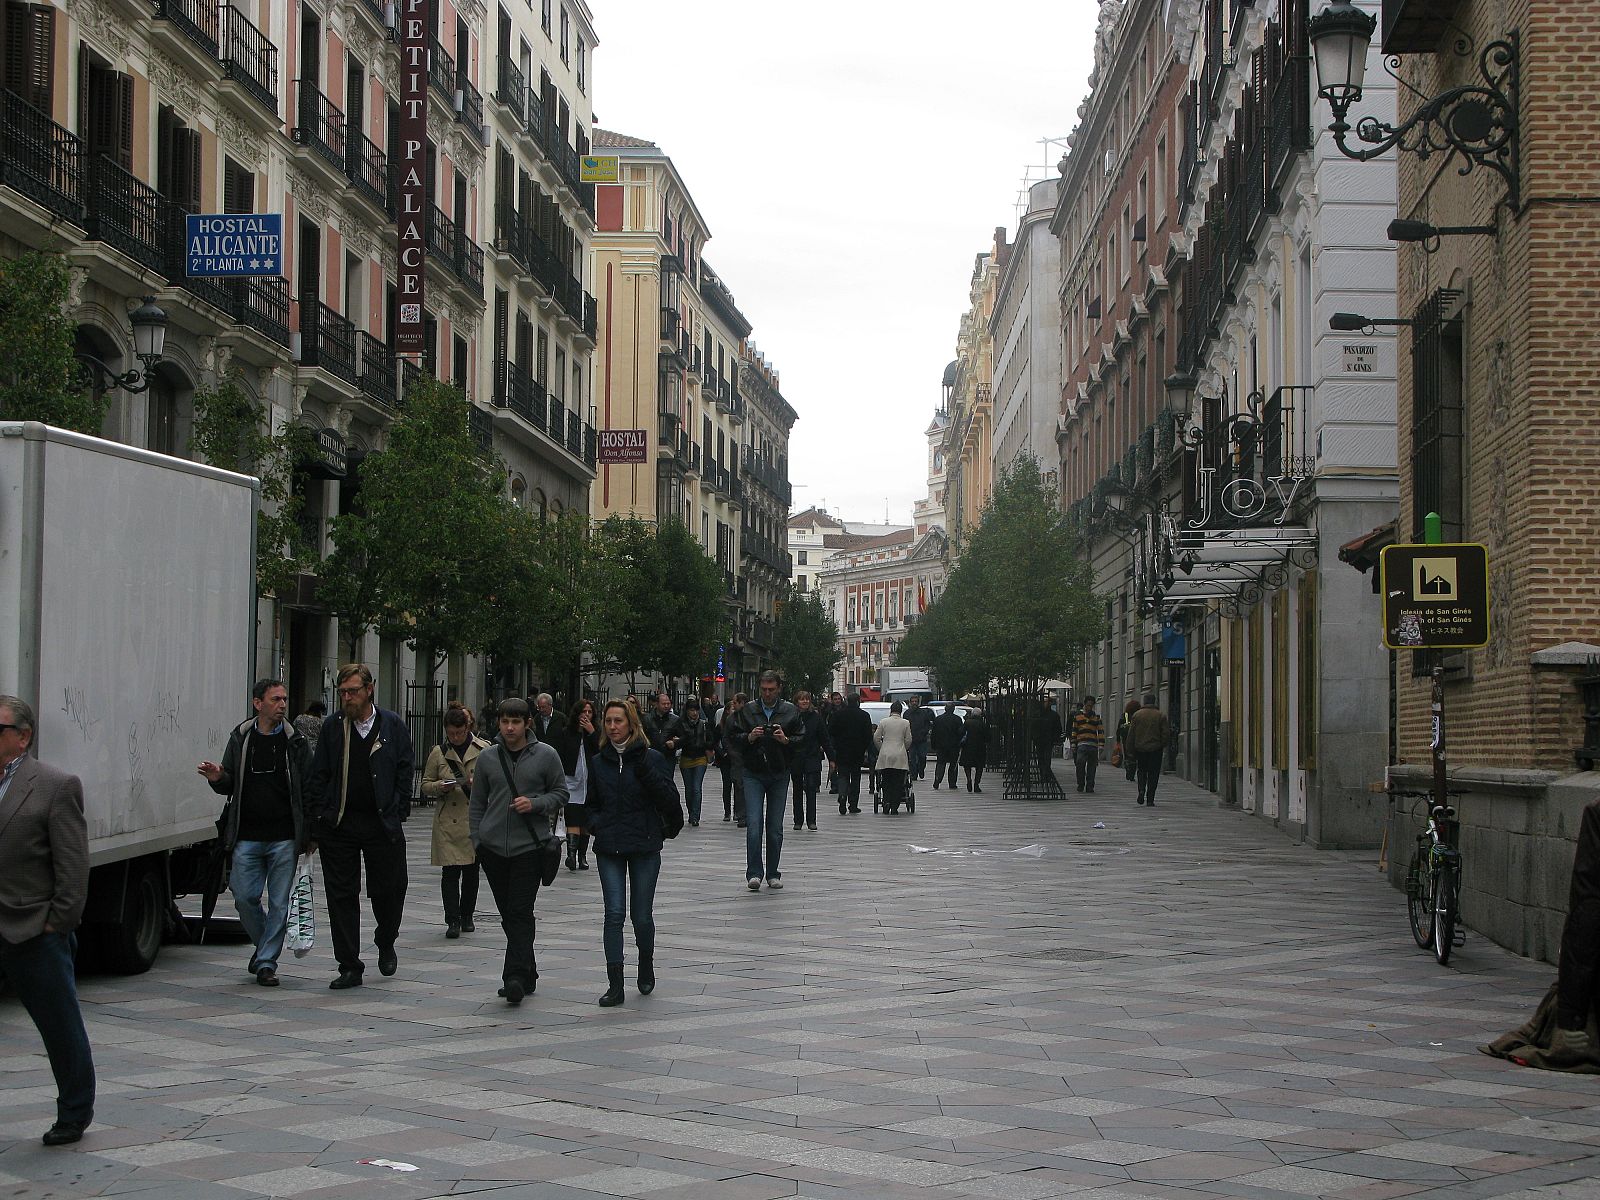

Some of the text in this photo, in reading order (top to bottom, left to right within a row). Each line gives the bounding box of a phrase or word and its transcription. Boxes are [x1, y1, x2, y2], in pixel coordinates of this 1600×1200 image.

[402, 0, 424, 294] PETIT PALACE
[199, 219, 268, 233] HOSTAL
[189, 235, 279, 256] ALICANTE
[206, 258, 244, 271] PLANTA
[1344, 346, 1374, 354] PASADIZO
[601, 432, 645, 447] HOSTAL
[604, 448, 643, 458] Don Alfonso
[1400, 608, 1423, 616] Iglesia
